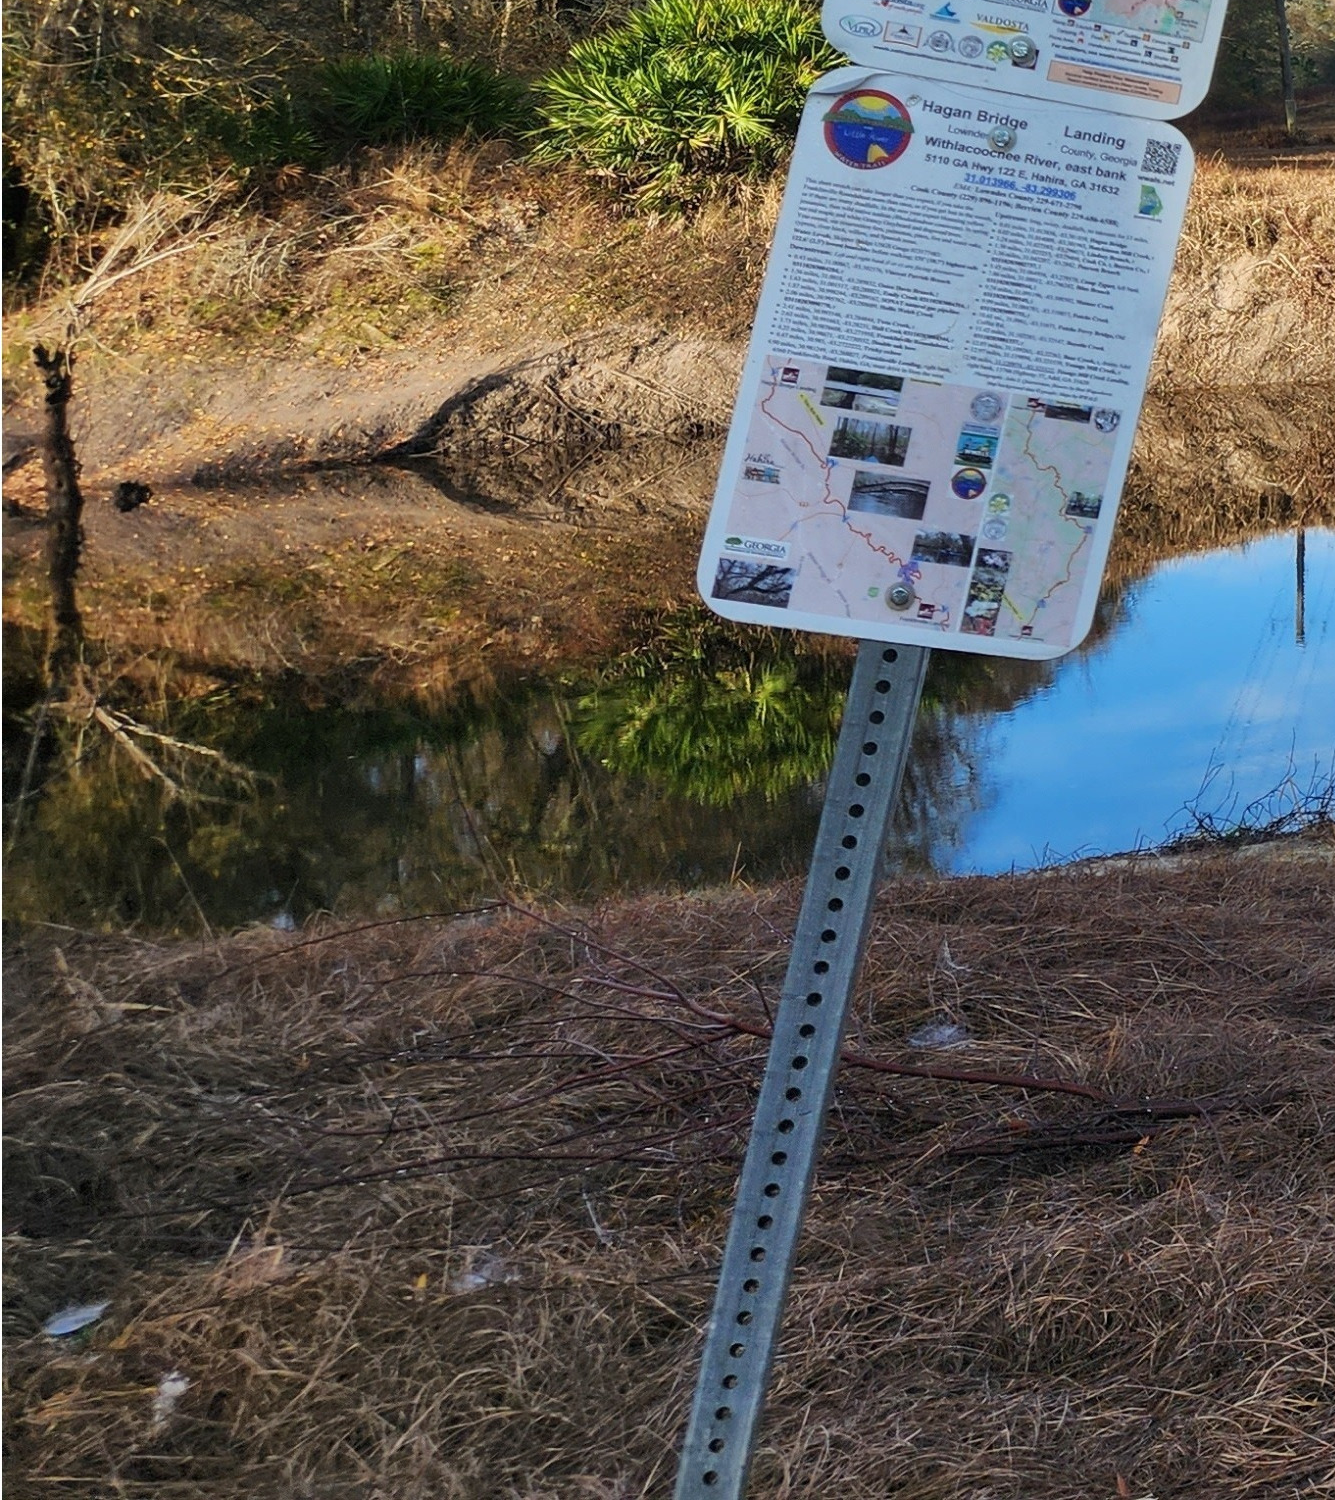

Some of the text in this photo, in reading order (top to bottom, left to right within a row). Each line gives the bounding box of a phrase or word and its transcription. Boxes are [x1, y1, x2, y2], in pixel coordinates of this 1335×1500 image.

[975, 13, 1030, 30] VALDOSTA
[921, 99, 1126, 149] Hagan Bridge Landing
[947, 124, 1137, 168] Lownde County, Georgia
[924, 153, 1120, 195] 5110 GA Hwy 122 E, Hahira, GA 31632
[1024, 153, 1062, 170] River,
[1064, 161, 1094, 175] east
[1095, 166, 1127, 181] bank
[743, 540, 786, 553] GEORGIA
